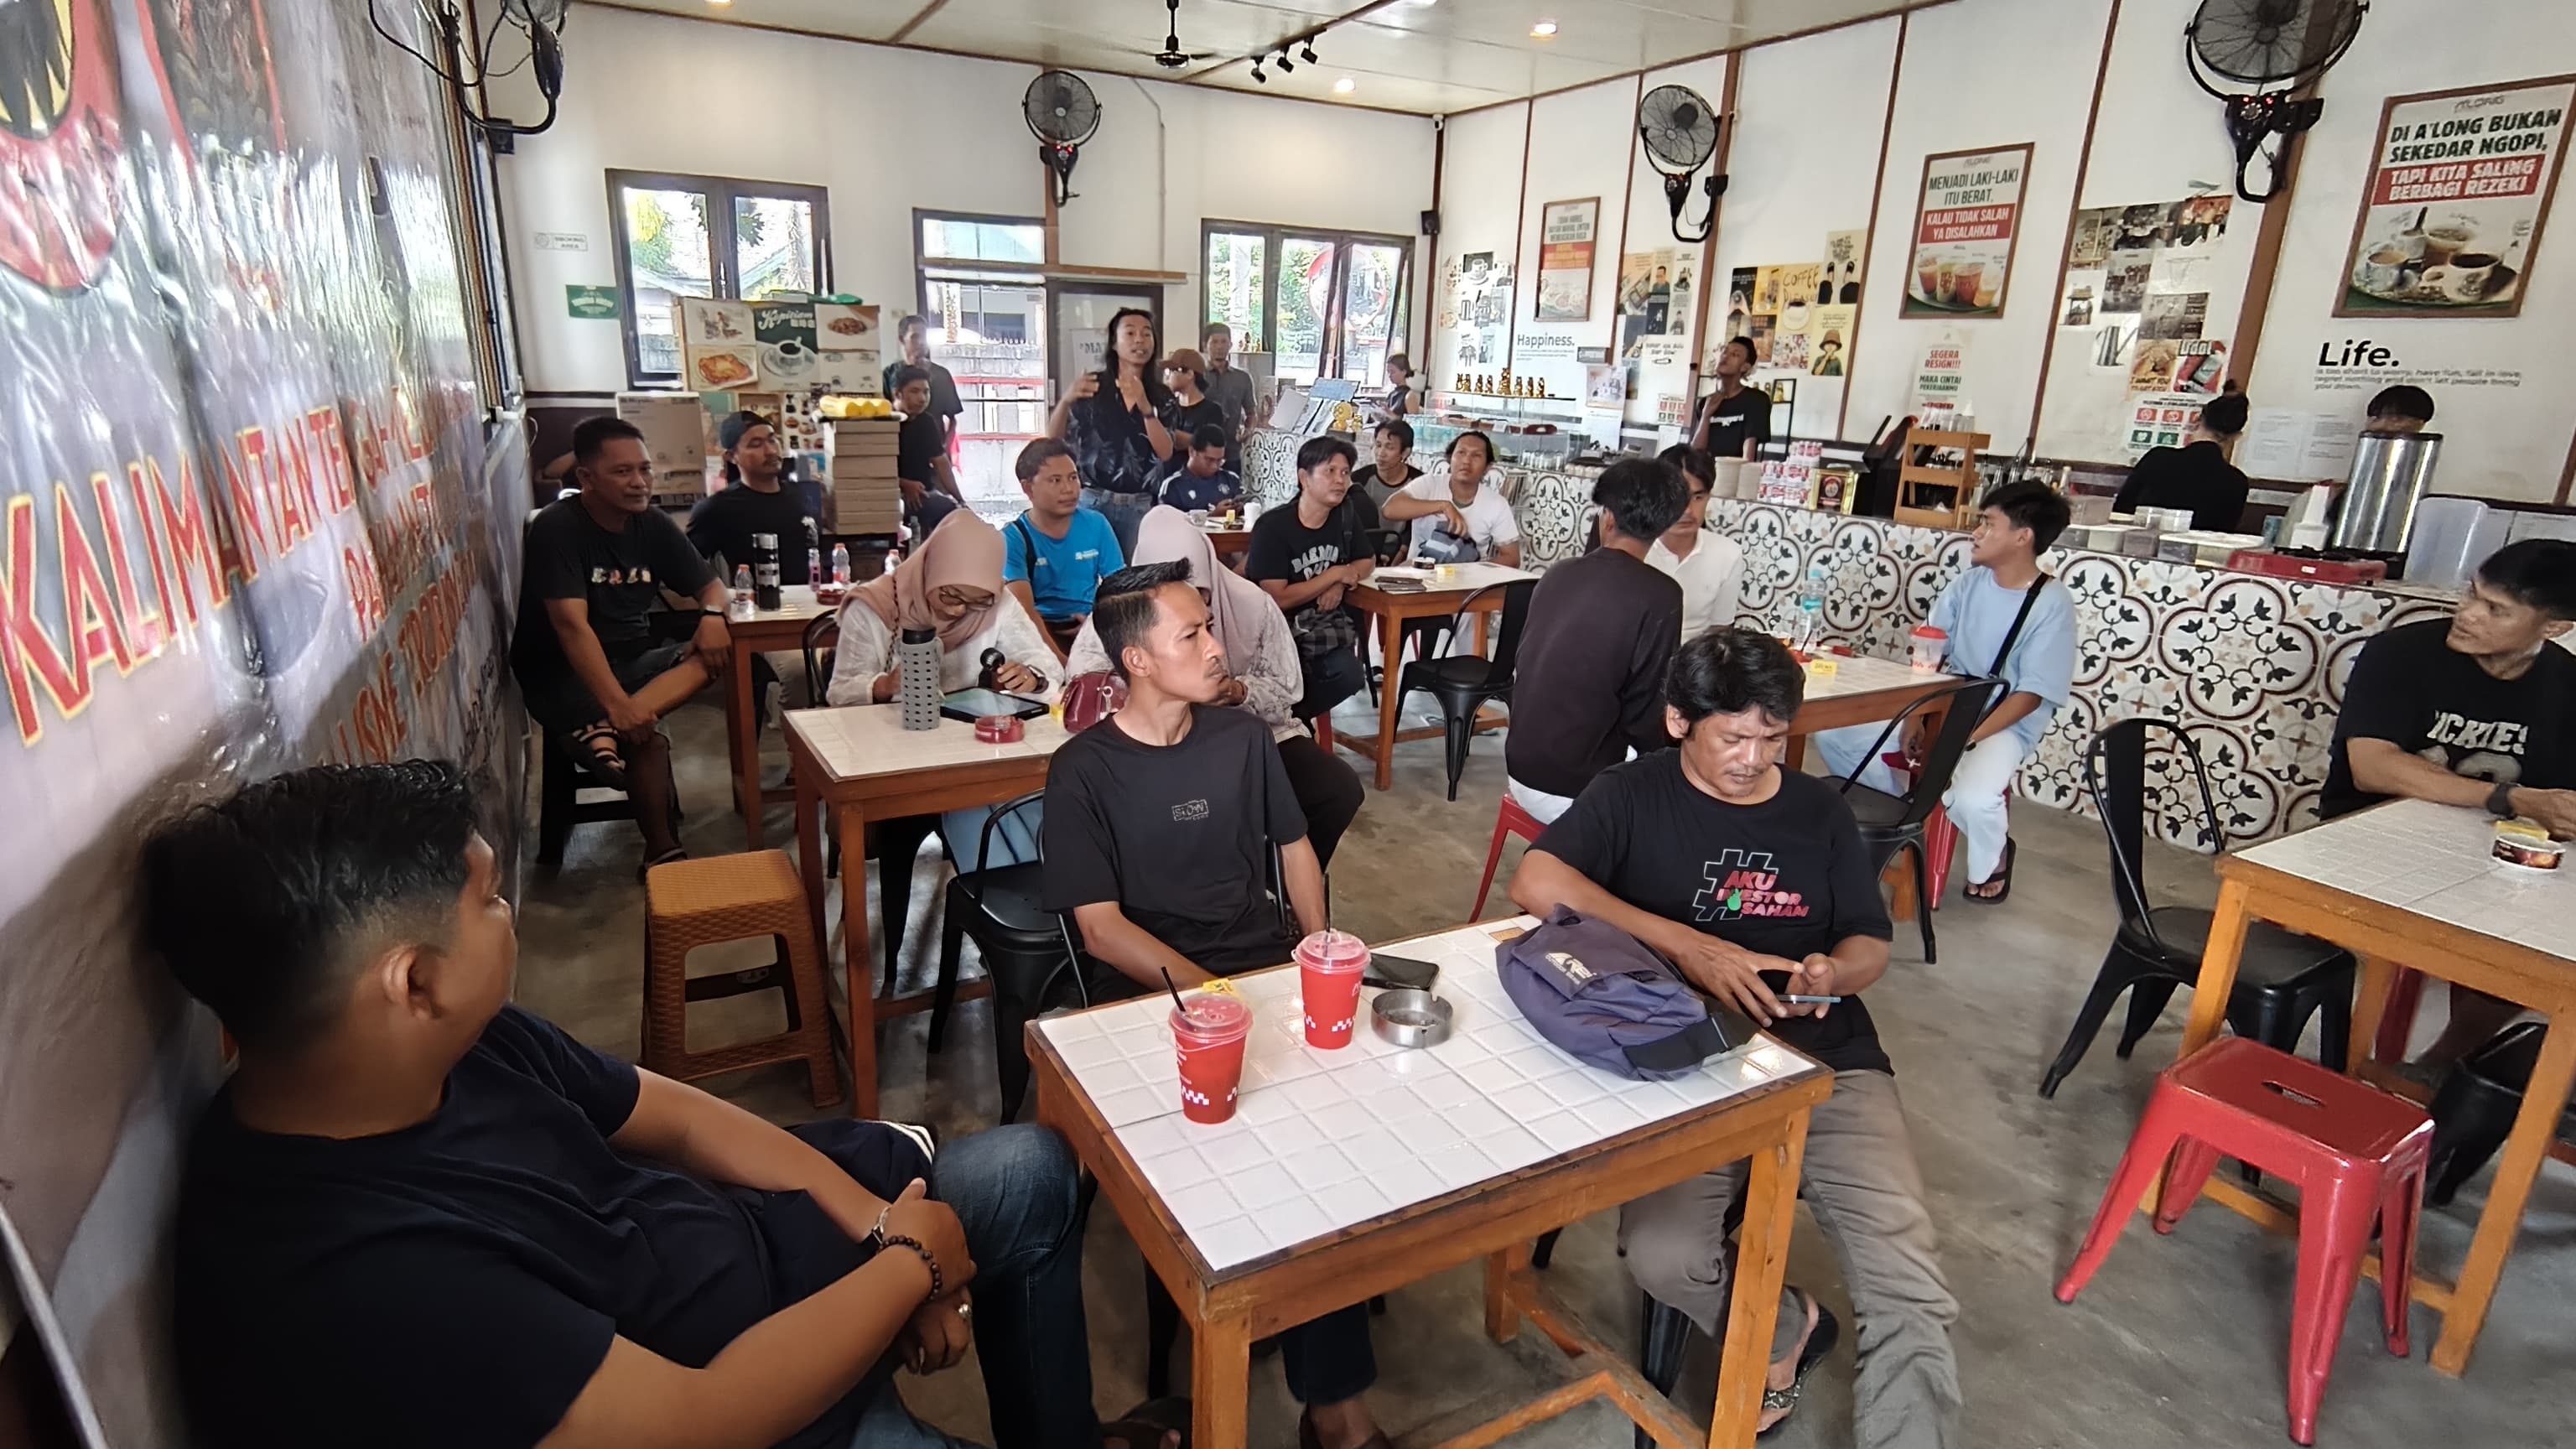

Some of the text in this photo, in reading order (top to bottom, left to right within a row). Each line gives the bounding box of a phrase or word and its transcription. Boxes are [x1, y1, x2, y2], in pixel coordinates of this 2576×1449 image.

[2390, 108, 2563, 143] DI A'LONG BUKAN
[2390, 132, 2547, 163] SEKEDAR NGOPI,
[1929, 169, 2019, 190] MENJADI LAKI-LAKI
[2391, 158, 2537, 184] TAPI KITA SALING
[1945, 189, 1993, 205] ITU BERAT,
[2389, 176, 2527, 201] BERBAGI REZEKI
[1927, 208, 2009, 225] KALAU TIDAK SALAH
[1933, 224, 1998, 240] YA DISALAHKAN
[1783, 265, 1819, 288] COFFEE
[1517, 332, 1575, 349] Happiness.
[1930, 350, 1959, 358] SEGERA
[2319, 339, 2399, 366] Life.
[1924, 359, 1961, 369] RESIGN!!!
[1940, 376, 1961, 384] CINTAI
[0, 417, 324, 748] KALIMANTAN
[1724, 870, 1777, 891] AKU
